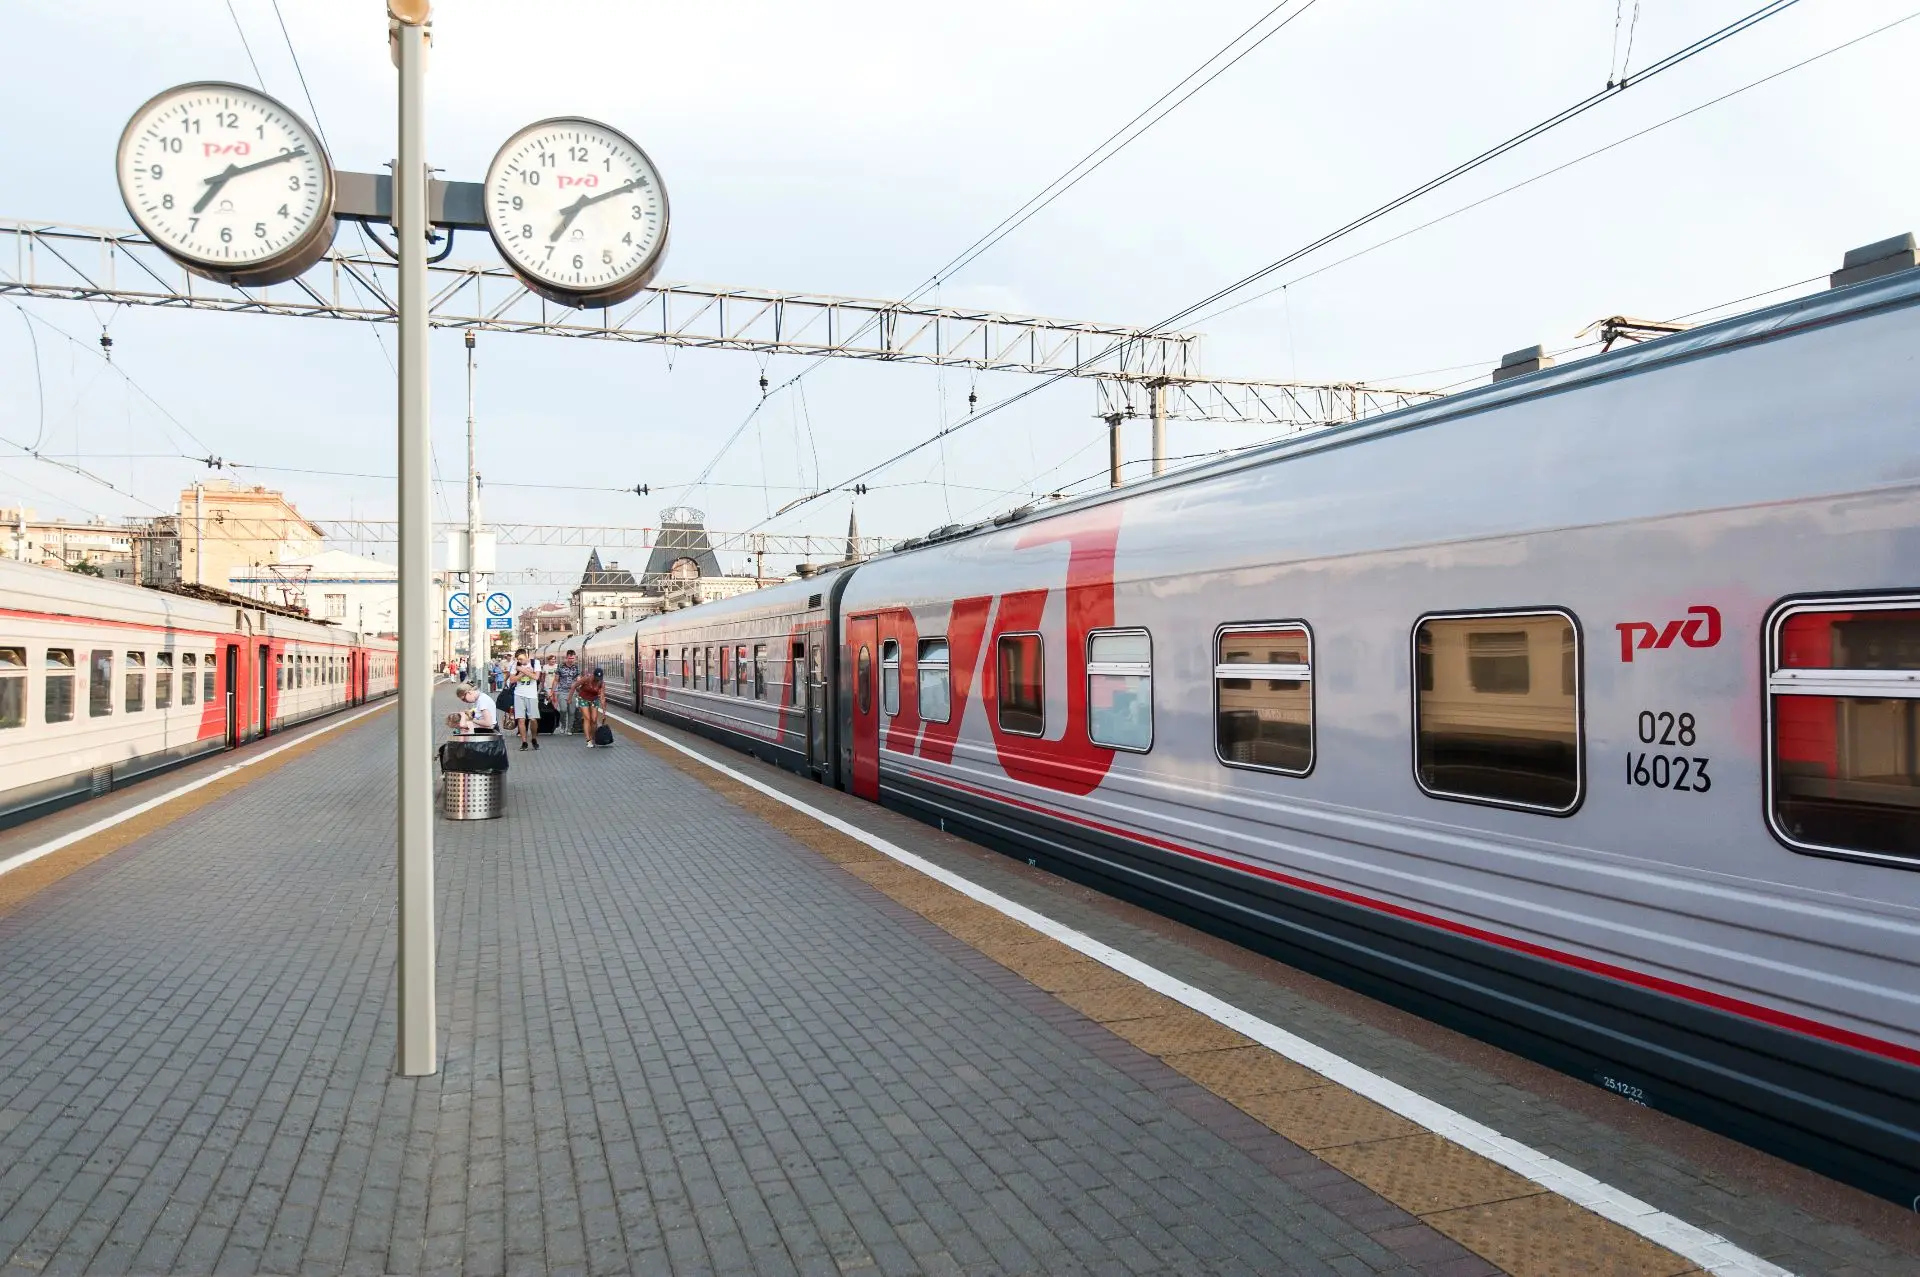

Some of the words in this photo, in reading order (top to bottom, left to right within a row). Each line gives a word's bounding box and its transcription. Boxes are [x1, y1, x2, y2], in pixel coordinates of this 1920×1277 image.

[181, 118, 201, 135] 11
[216, 112, 239, 129] 12
[256, 124, 265, 140] 1
[159, 137, 183, 153] 10
[538, 152, 556, 168] 11
[568, 147, 589, 163] 12
[151, 164, 163, 180] 9
[603, 157, 611, 172] 1
[289, 176, 300, 191] 3
[519, 170, 540, 186] 10
[162, 194, 175, 210] 8
[512, 196, 523, 211] 9
[277, 203, 290, 218] 4
[631, 205, 642, 220] 3
[188, 217, 200, 233] 7
[255, 222, 267, 238] 5
[522, 224, 533, 239] 8
[220, 227, 233, 243] 6
[622, 232, 632, 246] 4
[545, 245, 556, 260] 7
[602, 250, 613, 264] 5
[572, 254, 583, 269] 6
[1638, 710, 1696, 747] 028
[1626, 751, 1711, 793] 16023
[1604, 1076, 1643, 1099] 25.12.22
